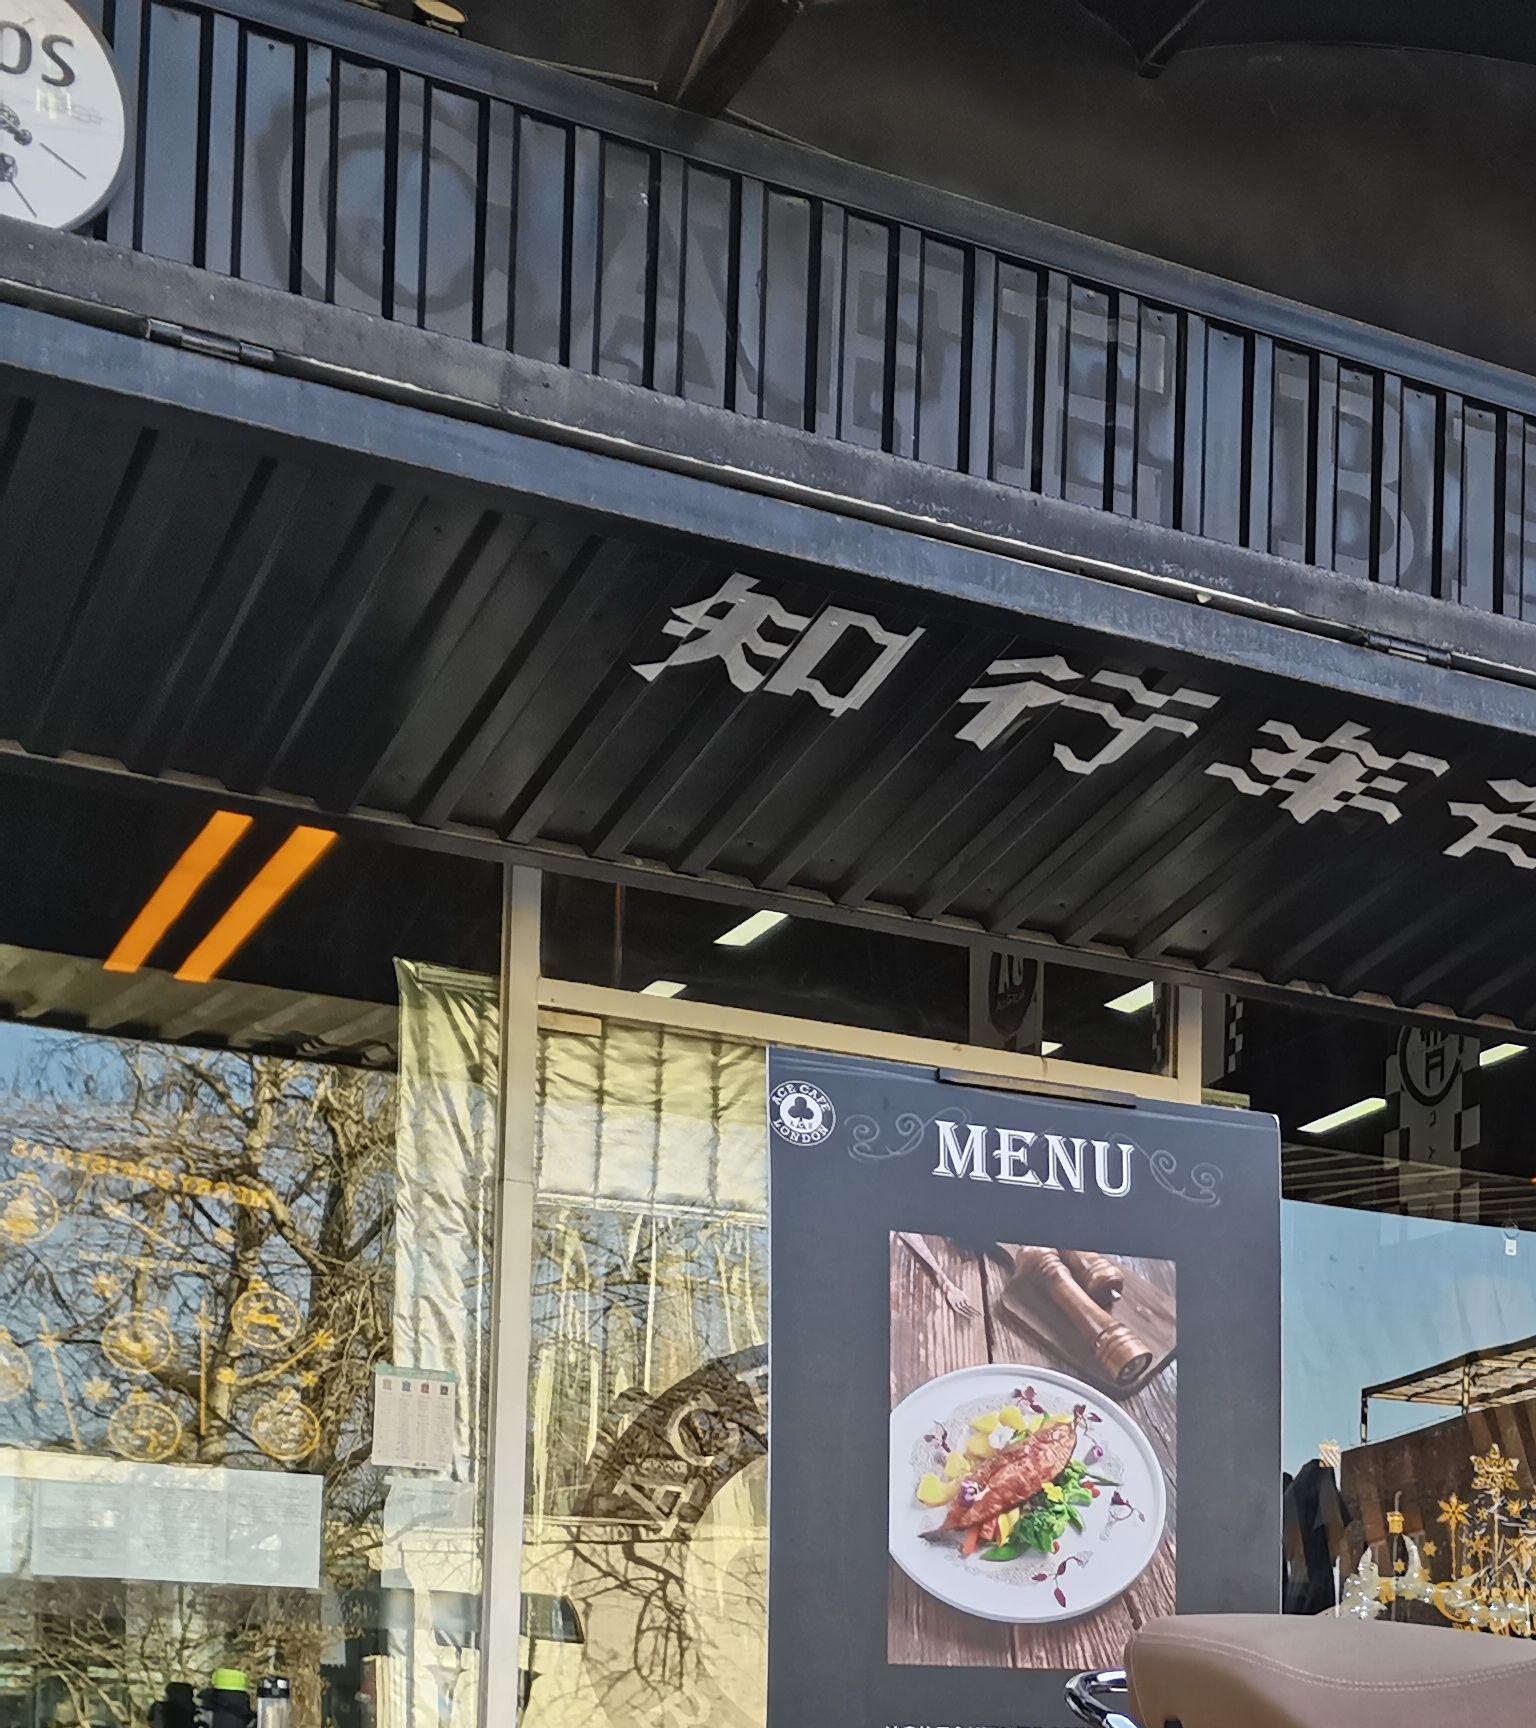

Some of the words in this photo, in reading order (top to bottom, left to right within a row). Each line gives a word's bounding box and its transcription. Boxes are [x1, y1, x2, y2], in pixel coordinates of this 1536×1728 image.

[771, 1083, 797, 1105] ACE
[799, 1084, 831, 1113] CAFE
[773, 1119, 829, 1143] LONDON
[932, 1119, 1136, 1198] MENU
